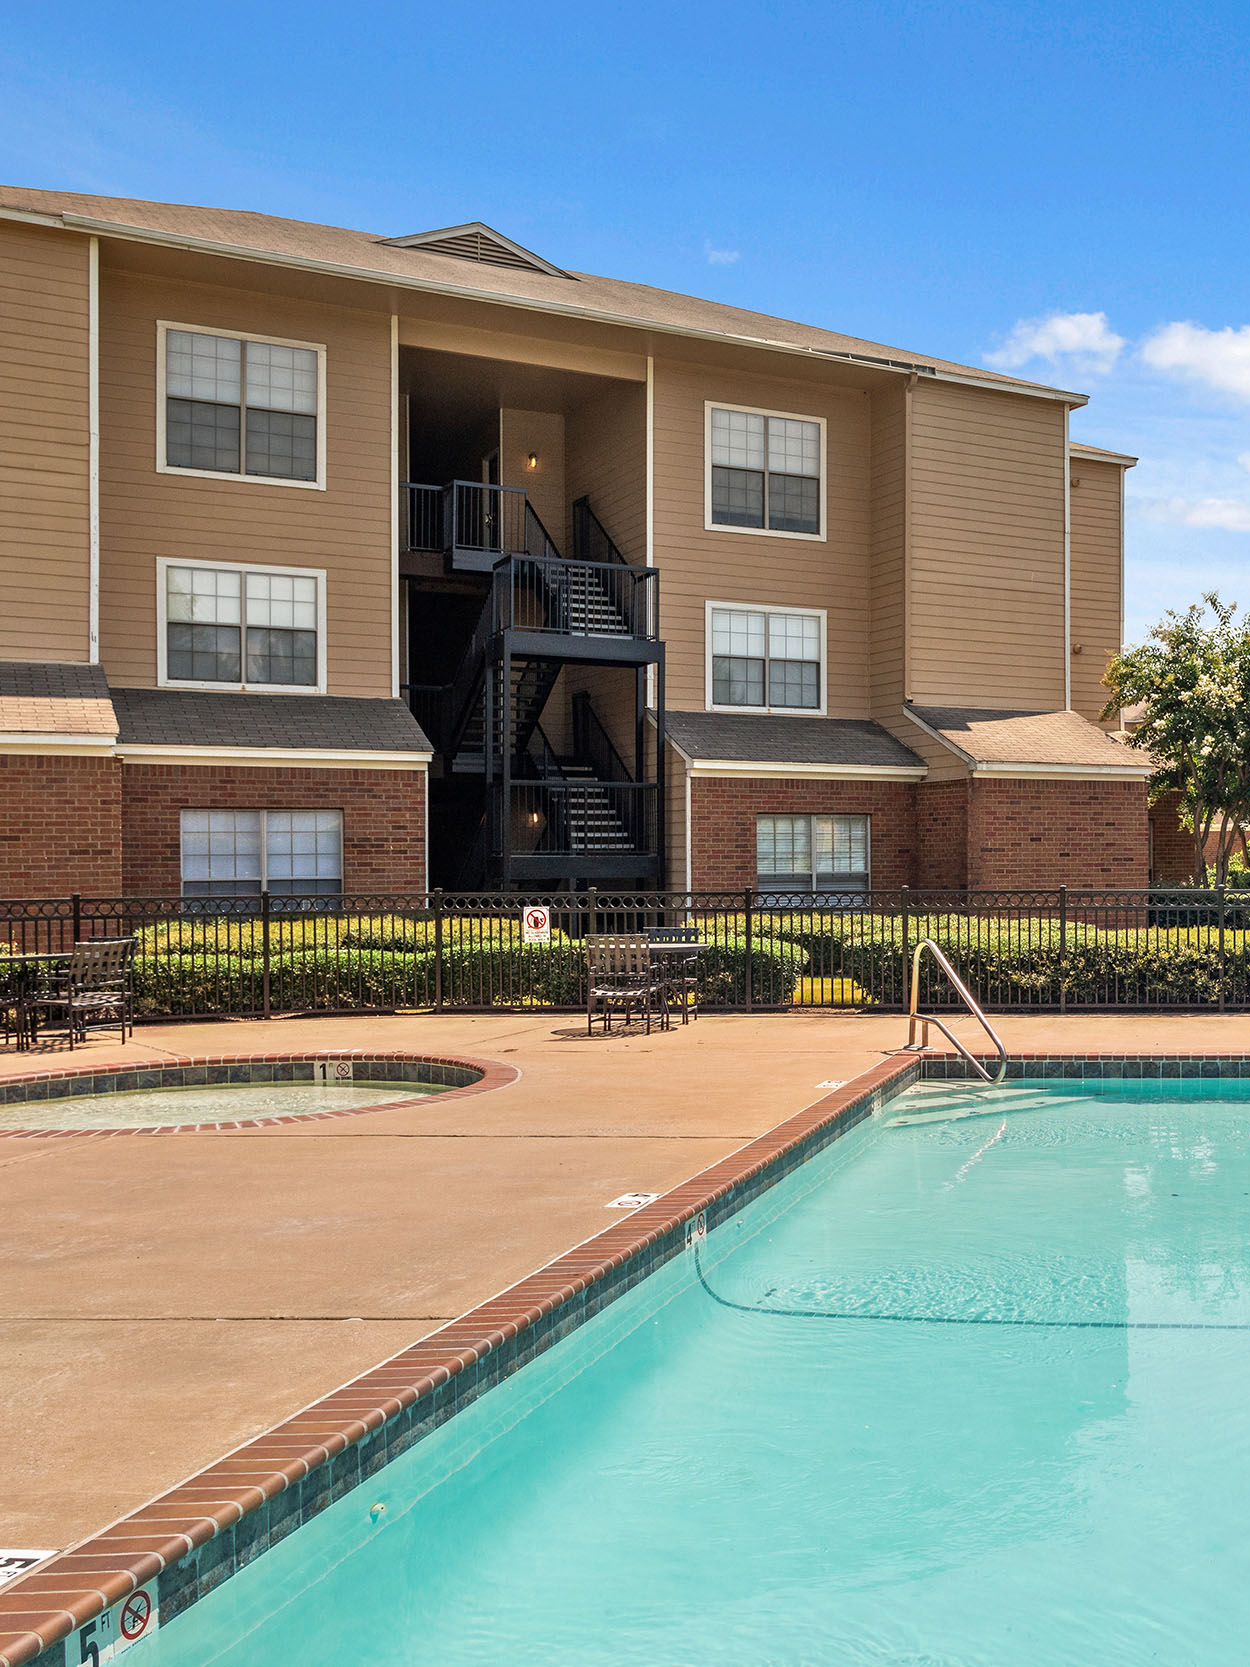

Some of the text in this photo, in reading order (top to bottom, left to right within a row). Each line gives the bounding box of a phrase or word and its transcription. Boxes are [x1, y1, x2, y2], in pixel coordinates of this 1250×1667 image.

[319, 1063, 327, 1080] 1
[686, 1223, 692, 1245] 4
[79, 1610, 111, 1667] 5 FT
